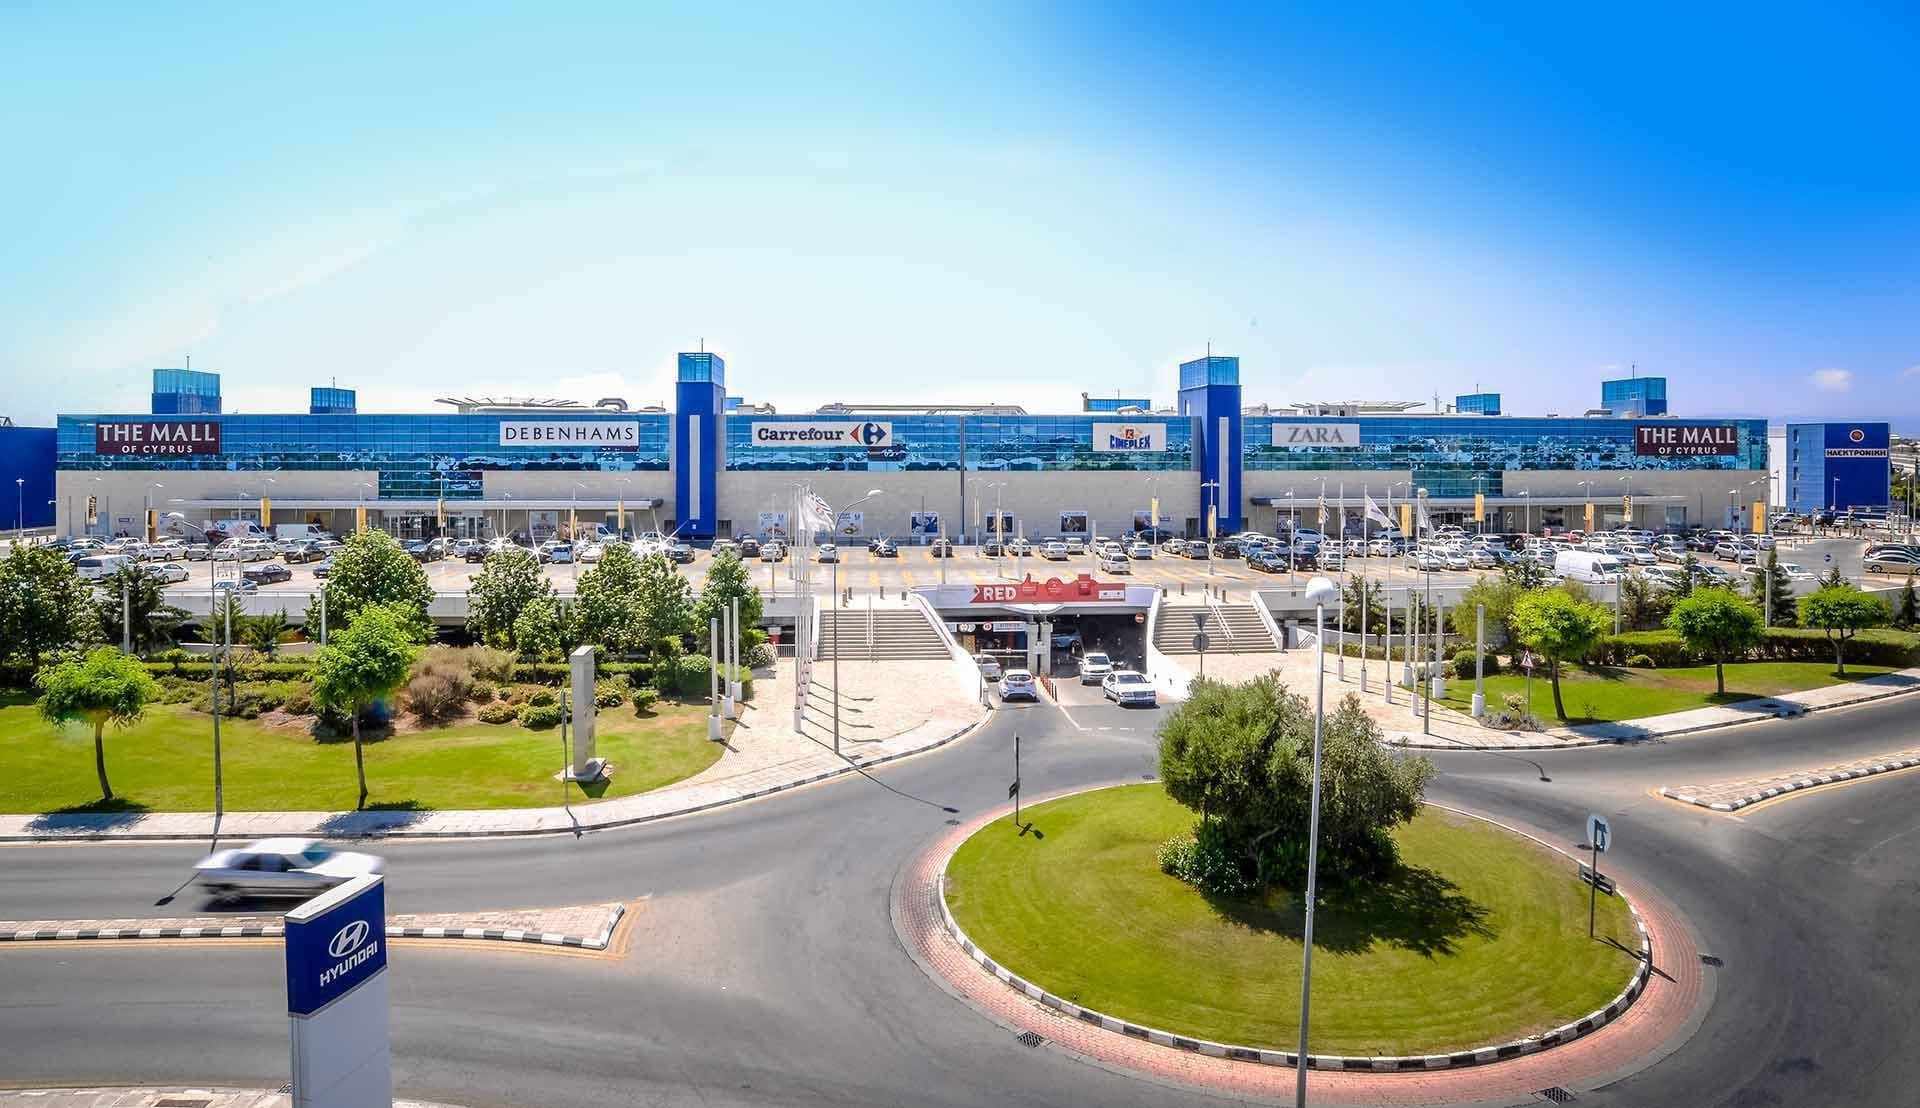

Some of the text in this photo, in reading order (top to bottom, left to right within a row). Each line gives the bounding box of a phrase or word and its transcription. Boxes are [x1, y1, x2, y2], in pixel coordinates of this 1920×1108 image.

[98, 424, 216, 442] THE MALL
[505, 427, 633, 440] DEBENHAMS
[757, 427, 845, 441] Carrefour
[1288, 427, 1344, 443] ZARA
[1640, 427, 1736, 444] THE MALL
[1110, 434, 1151, 449] CINEPLEX
[121, 445, 193, 453] OF CYPRUS
[1658, 446, 1718, 455] OF CYPRUS
[1507, 511, 1513, 524] 2
[983, 586, 1017, 600] RED
[320, 941, 378, 987] HYUNDAI
